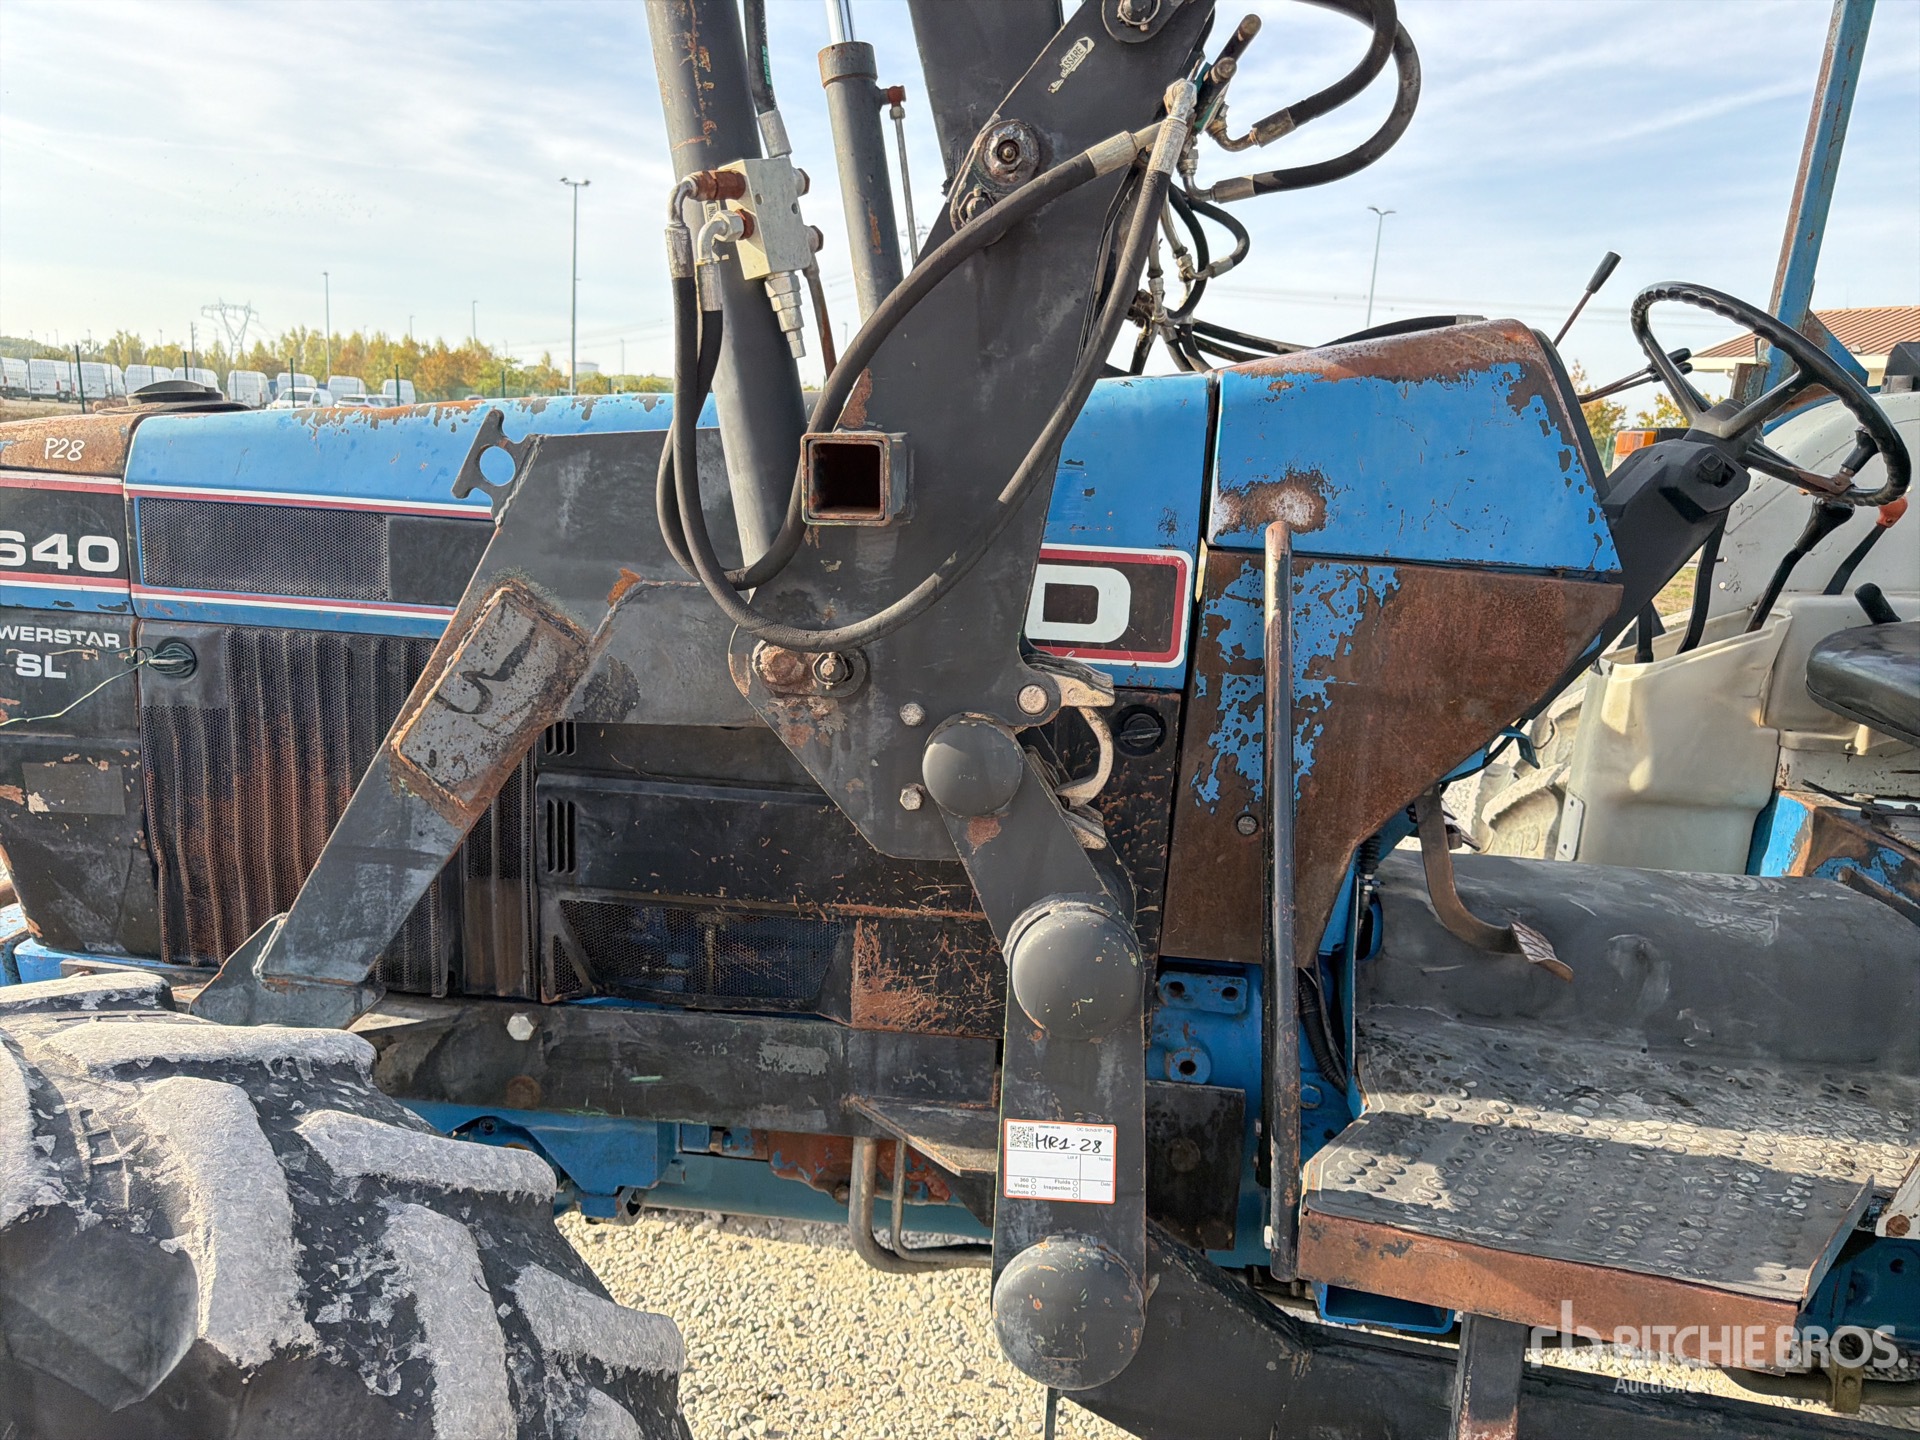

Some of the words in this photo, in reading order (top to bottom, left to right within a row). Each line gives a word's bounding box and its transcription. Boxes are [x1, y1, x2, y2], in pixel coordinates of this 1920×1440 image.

[45, 437, 85, 461] P28
[16, 653, 67, 680] SL
[1043, 1184, 1071, 1192] Inspection
